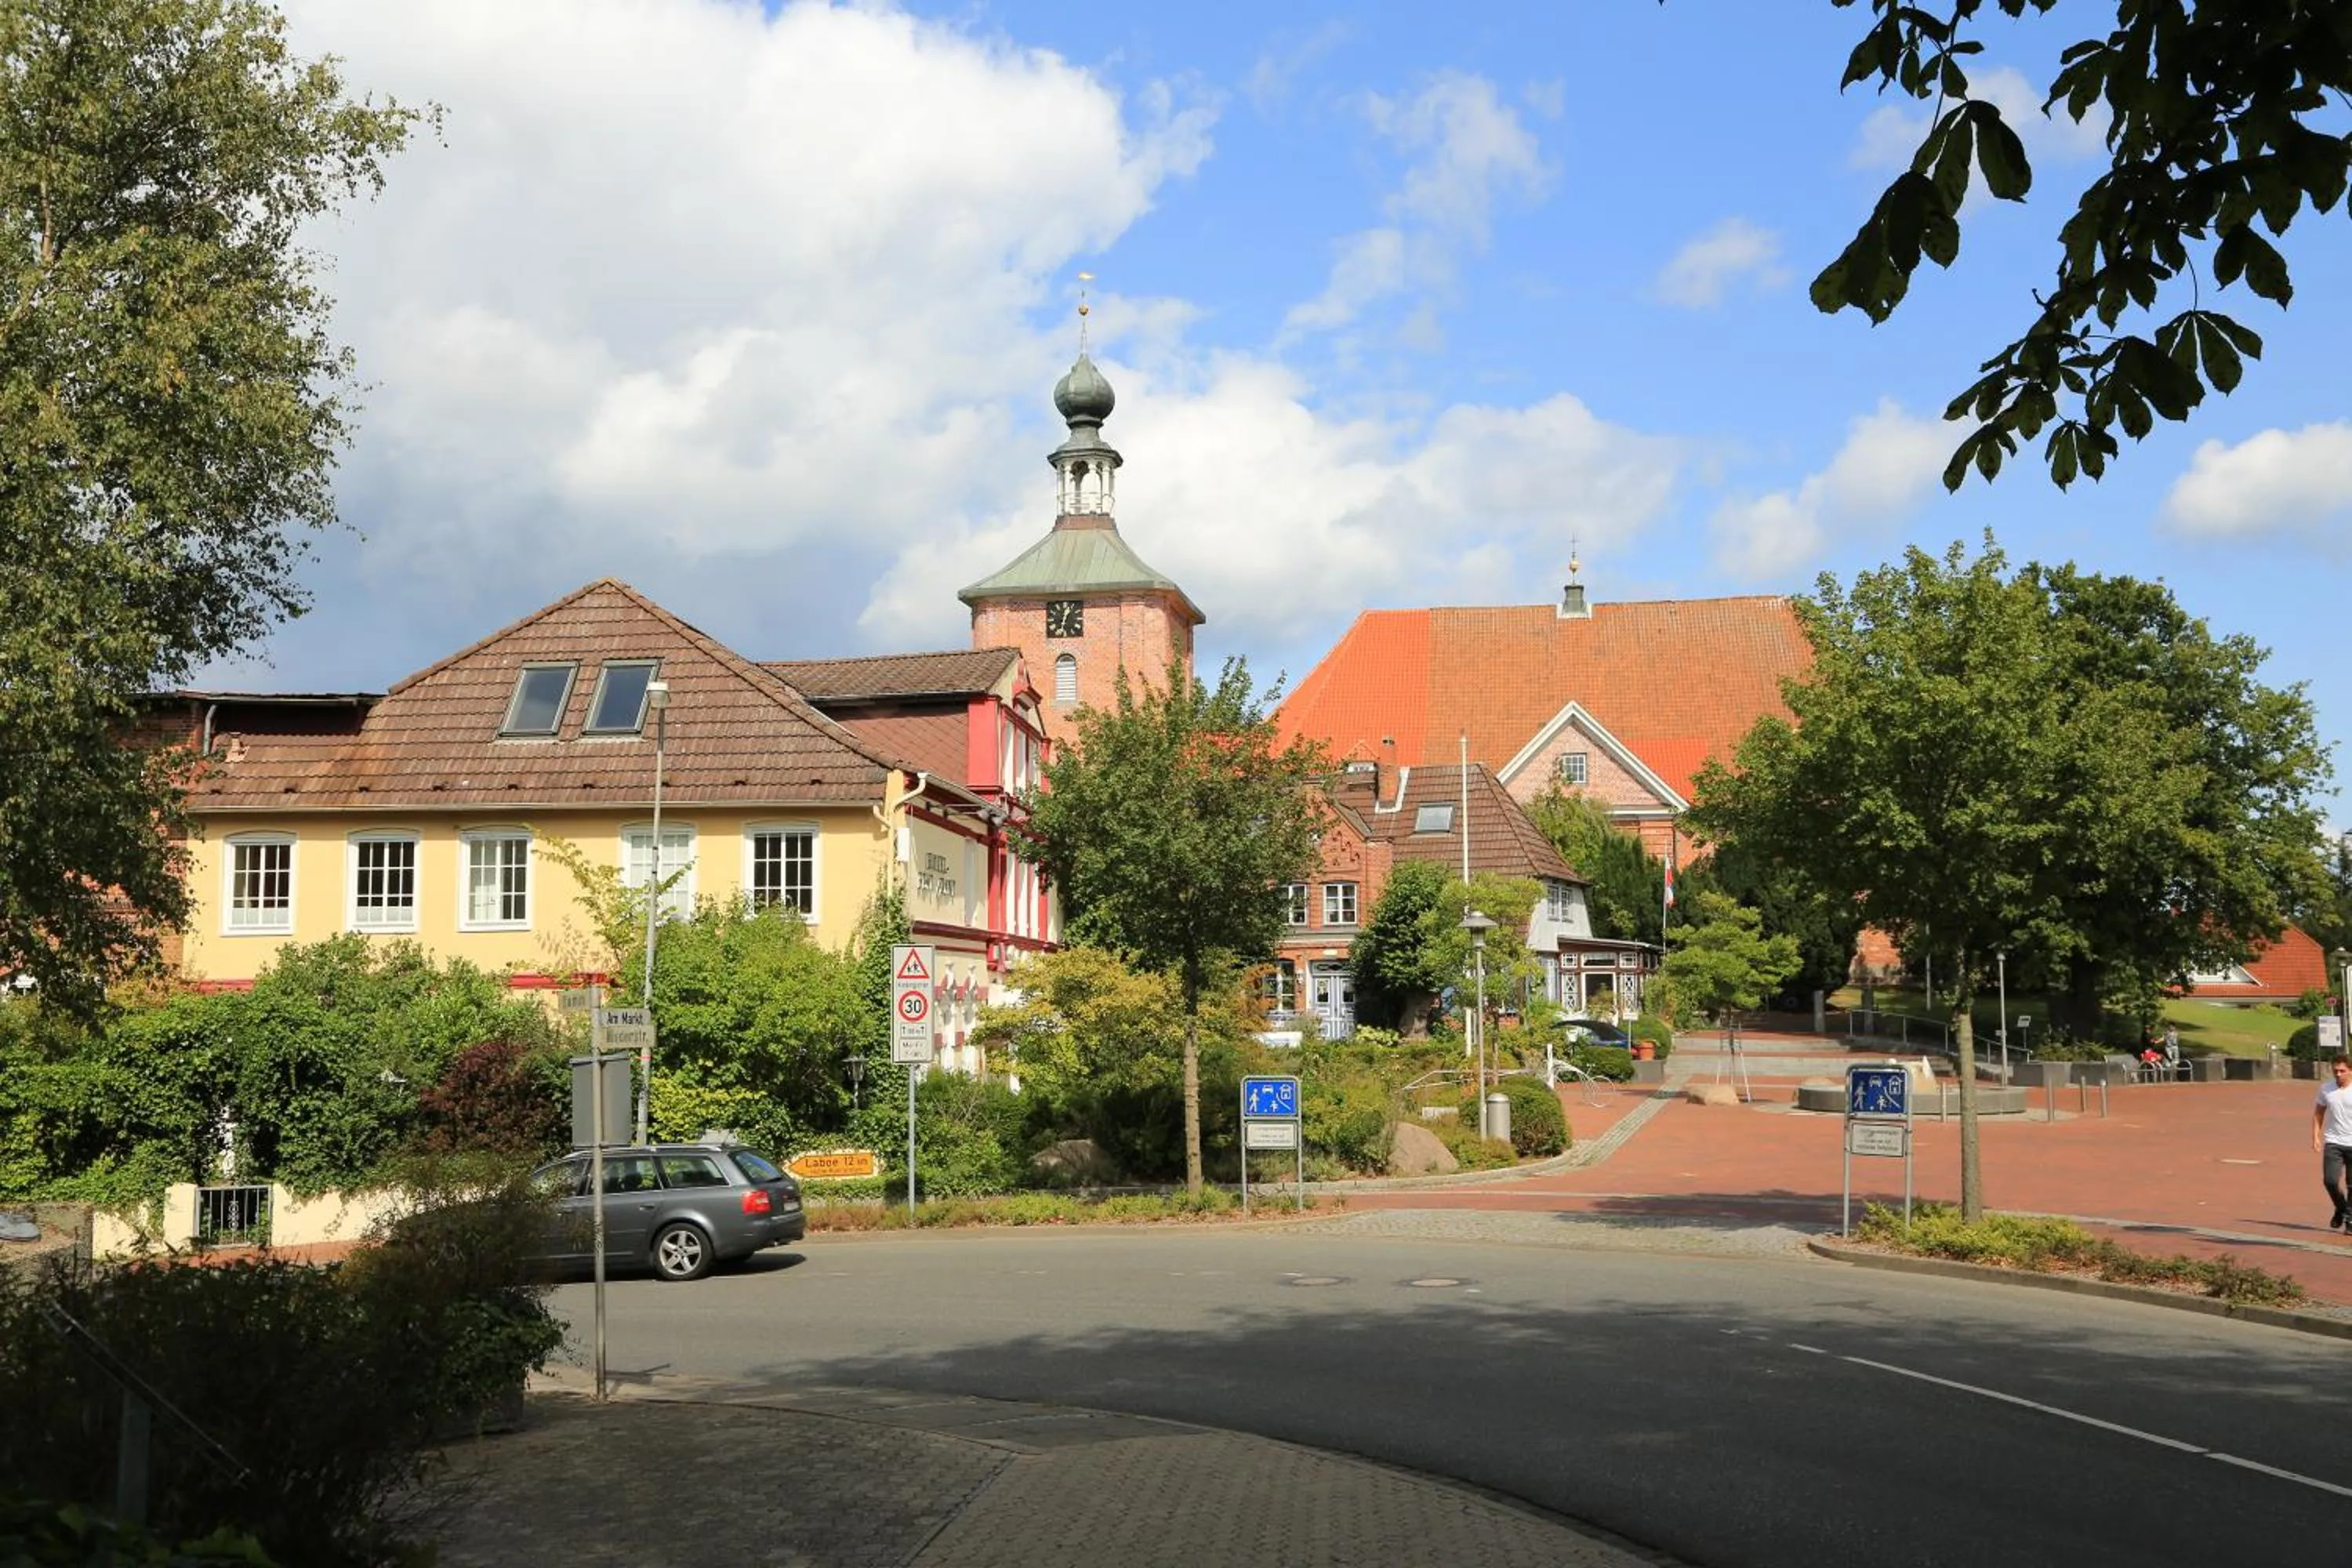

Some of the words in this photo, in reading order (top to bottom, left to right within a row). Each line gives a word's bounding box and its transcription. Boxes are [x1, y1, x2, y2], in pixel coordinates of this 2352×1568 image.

[904, 999, 922, 1014] 30
[607, 1011, 619, 1024] Am
[622, 1011, 644, 1025] Markt
[805, 1158, 838, 1167] Laboe
[844, 1155, 854, 1166] 12
